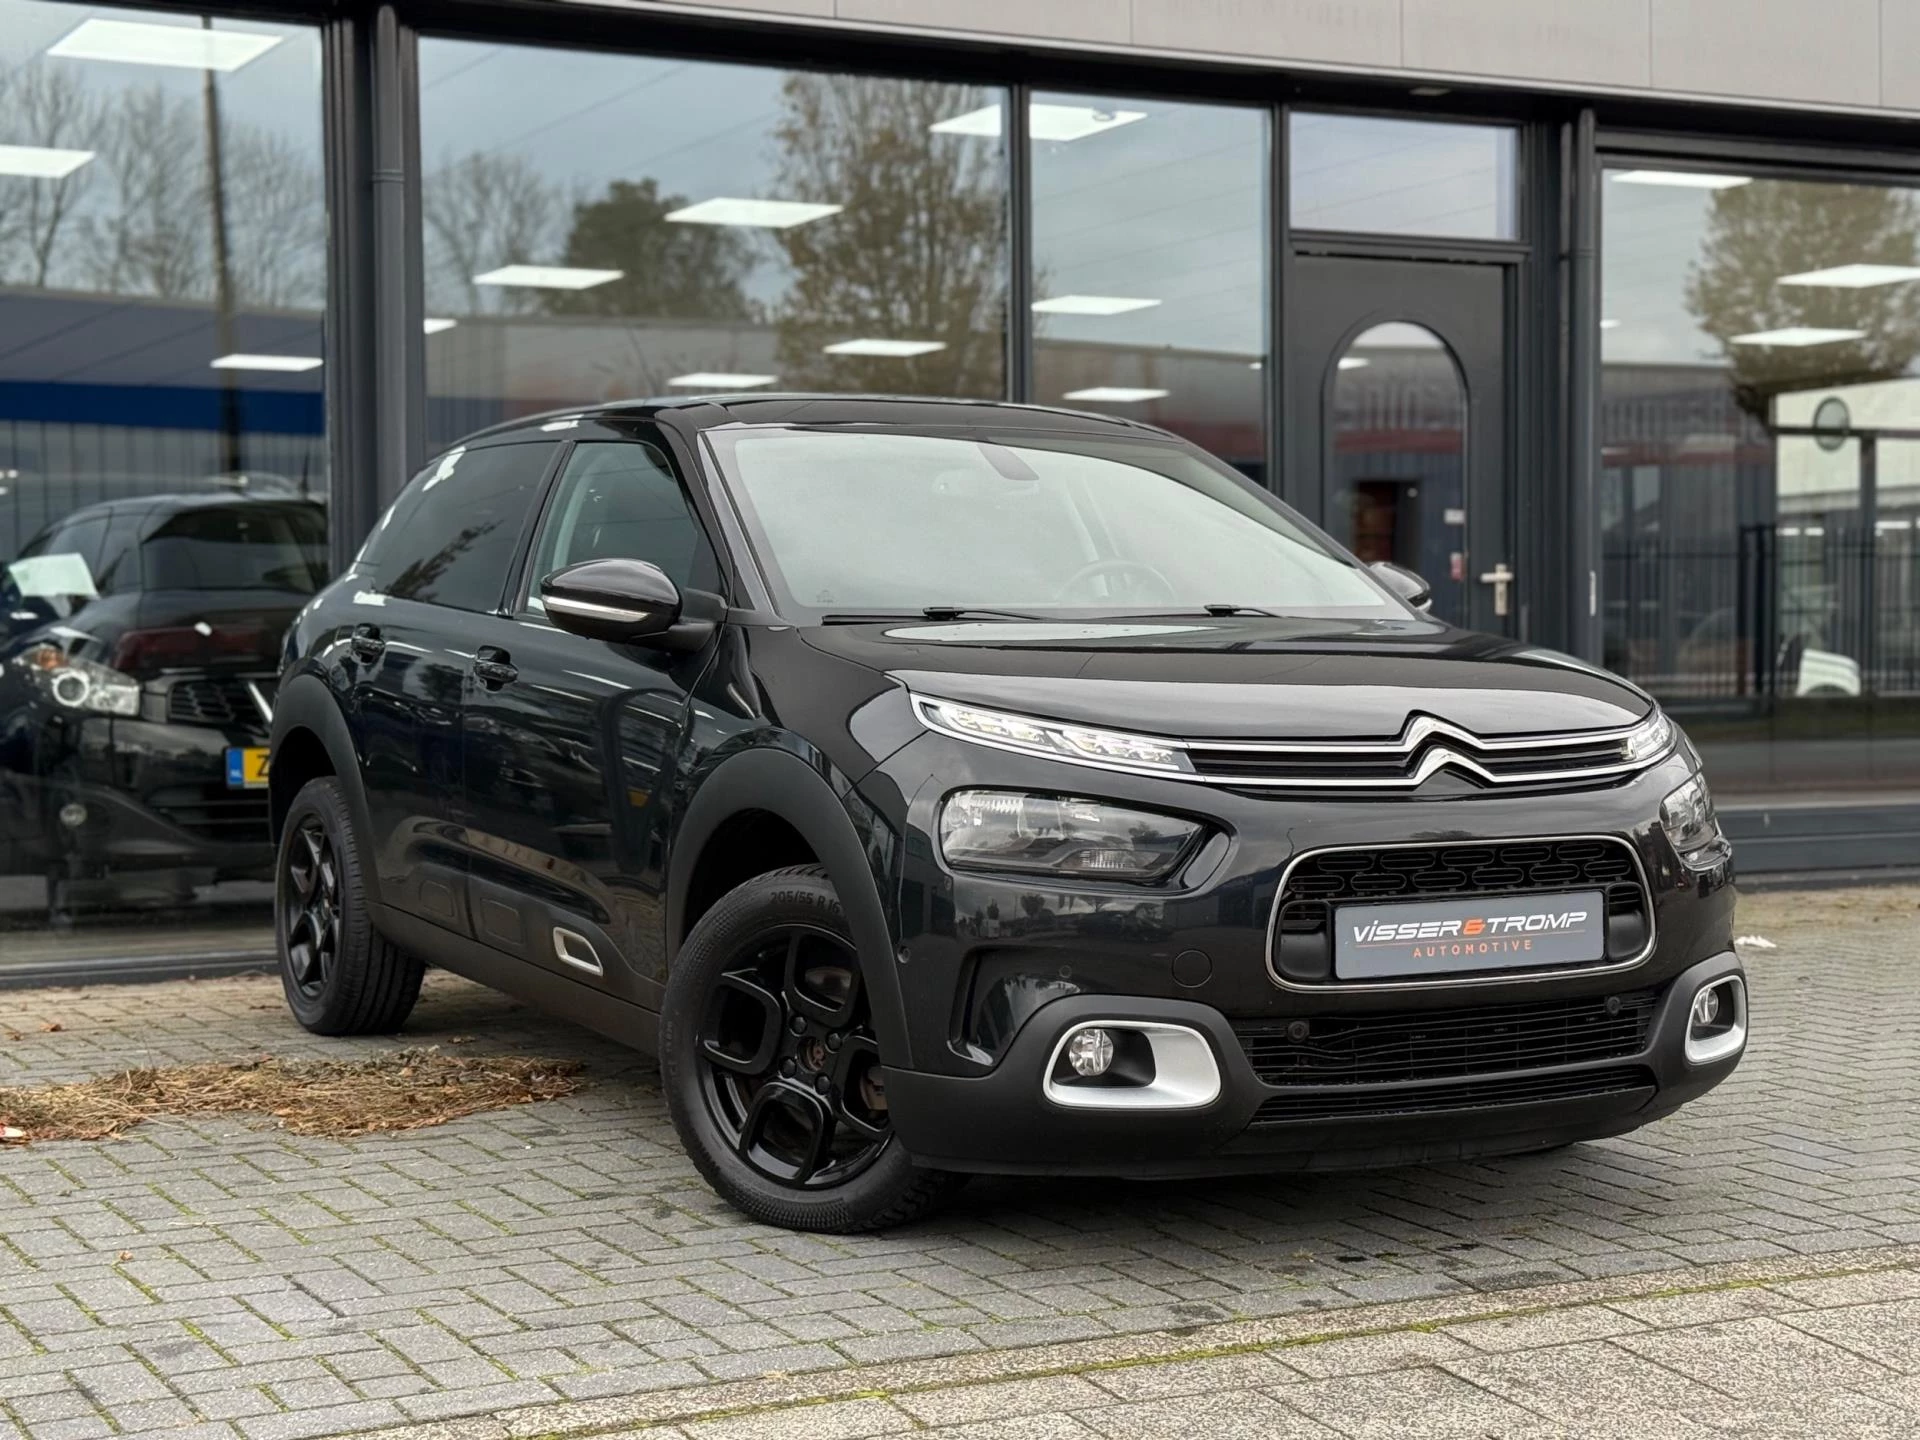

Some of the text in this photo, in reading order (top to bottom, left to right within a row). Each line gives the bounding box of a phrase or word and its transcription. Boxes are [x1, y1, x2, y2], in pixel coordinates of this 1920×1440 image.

[770, 890, 814, 905] 205/55
[817, 896, 826, 910] R
[1413, 939, 1533, 958] AUTOMOTIVE
